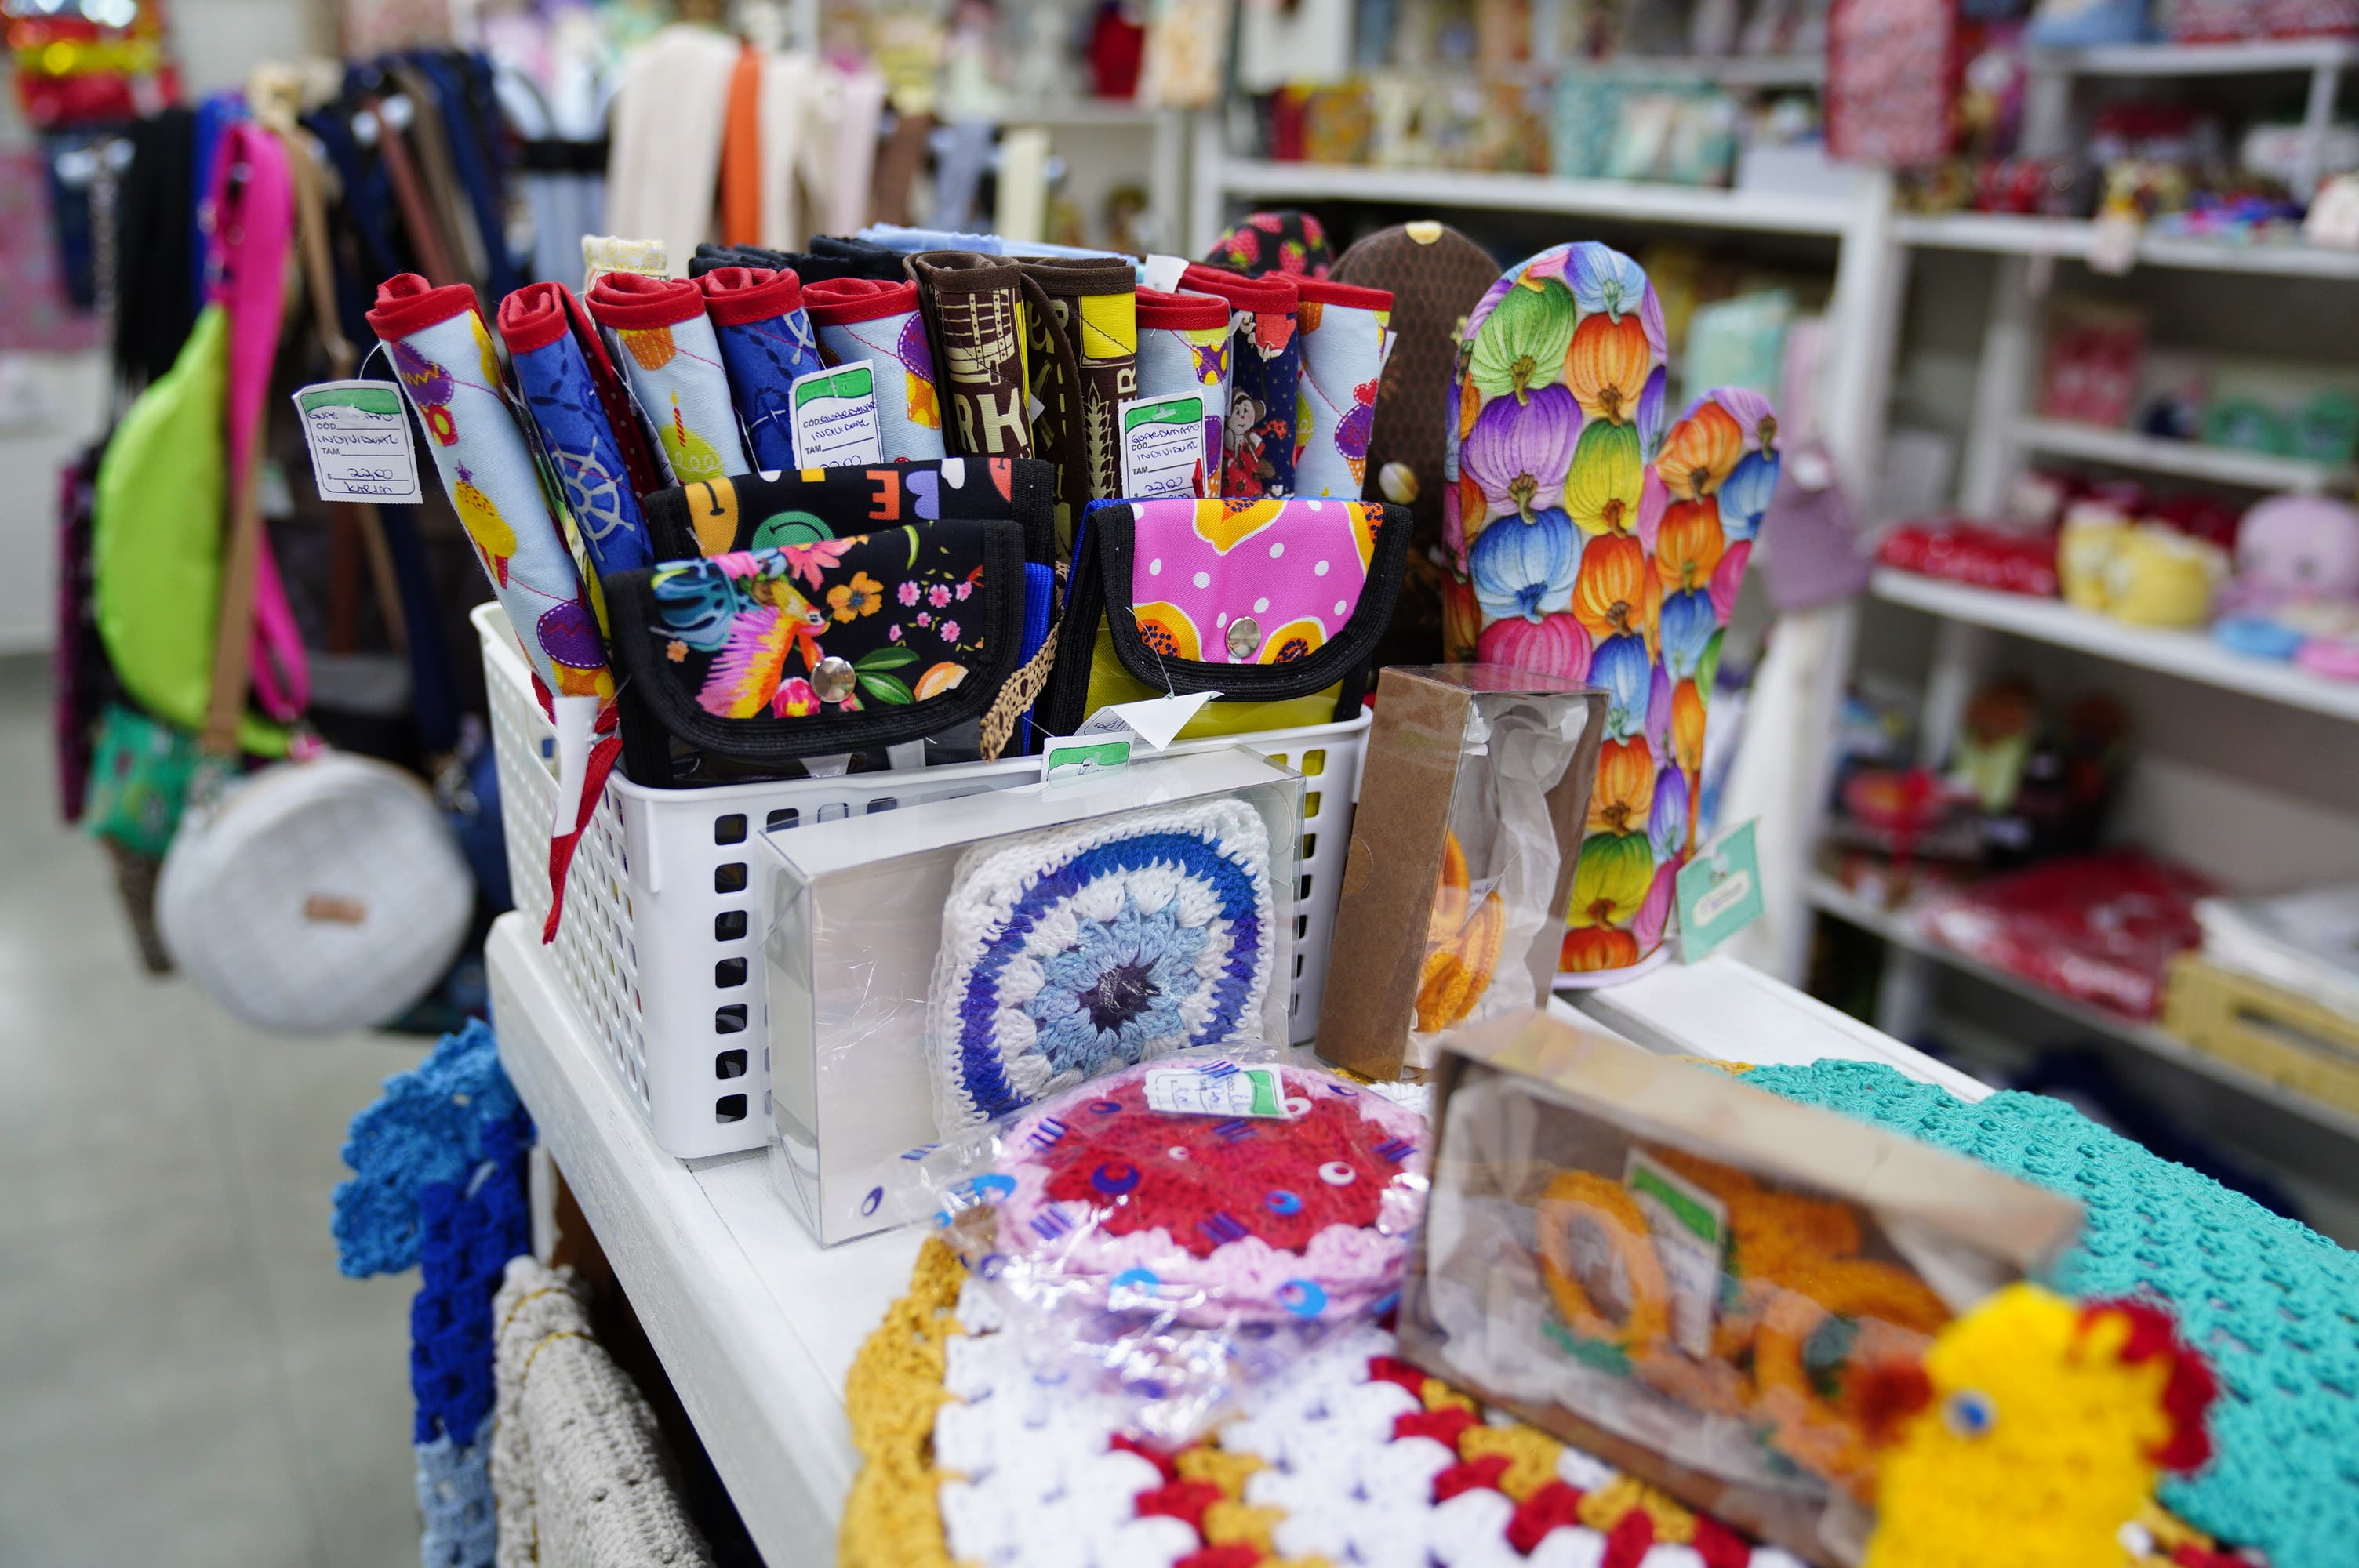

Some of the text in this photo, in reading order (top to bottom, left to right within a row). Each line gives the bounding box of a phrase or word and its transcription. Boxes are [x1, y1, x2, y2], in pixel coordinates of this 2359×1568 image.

[803, 419, 820, 428] CÓD
[805, 445, 822, 455] TAM
[1132, 466, 1148, 475] TAM
